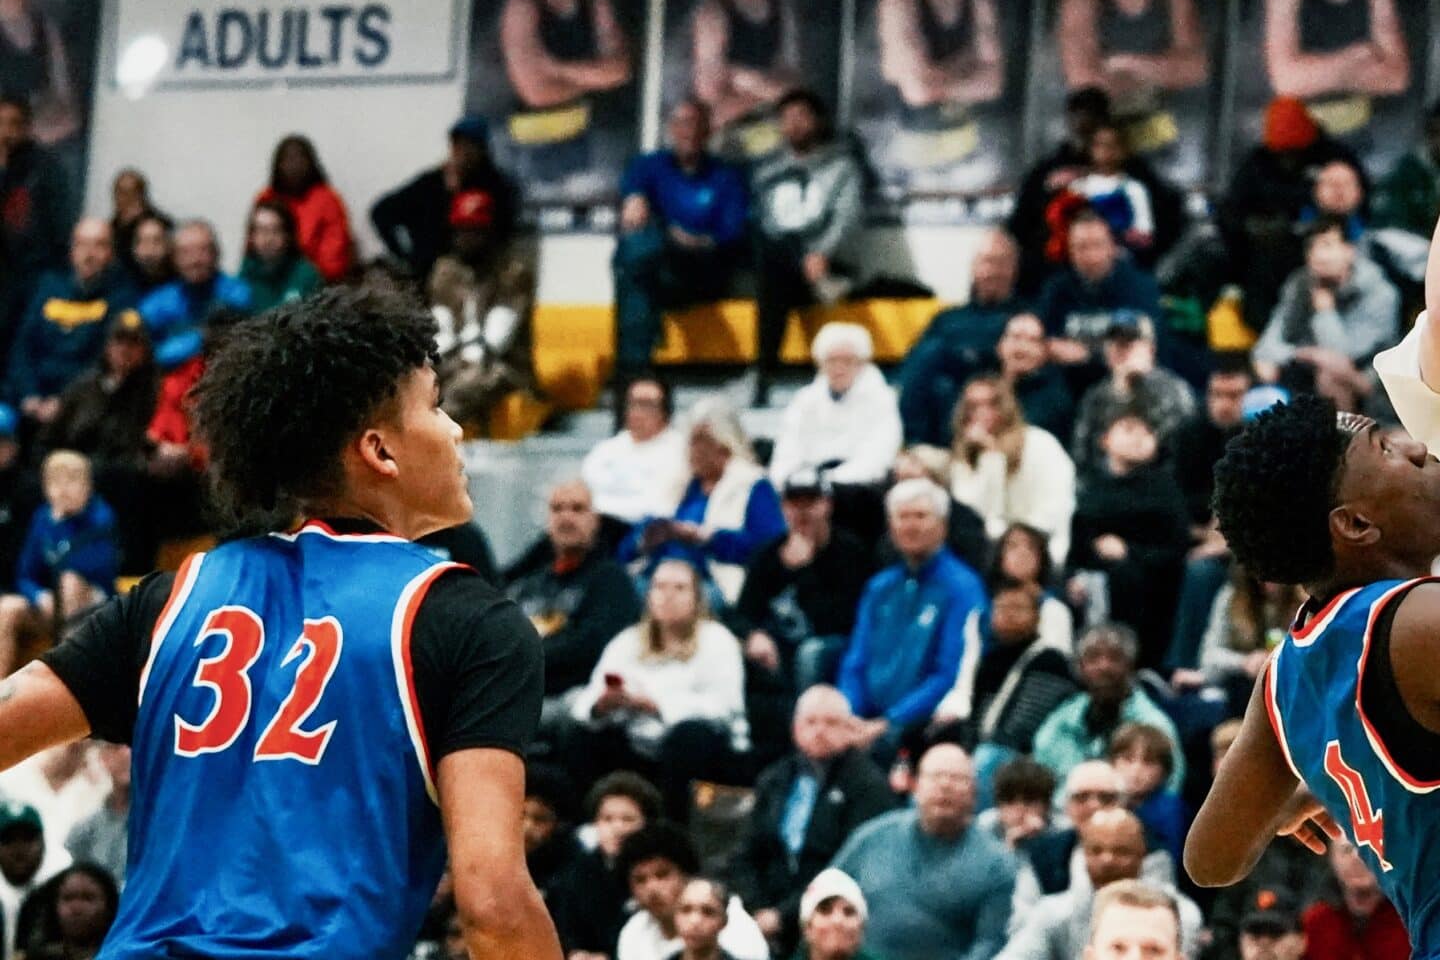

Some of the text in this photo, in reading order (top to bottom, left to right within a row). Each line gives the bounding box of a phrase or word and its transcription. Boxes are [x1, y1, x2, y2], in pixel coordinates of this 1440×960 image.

[175, 2, 393, 69] ADULTS
[174, 605, 343, 765] 32
[1324, 739, 1393, 873] 4
